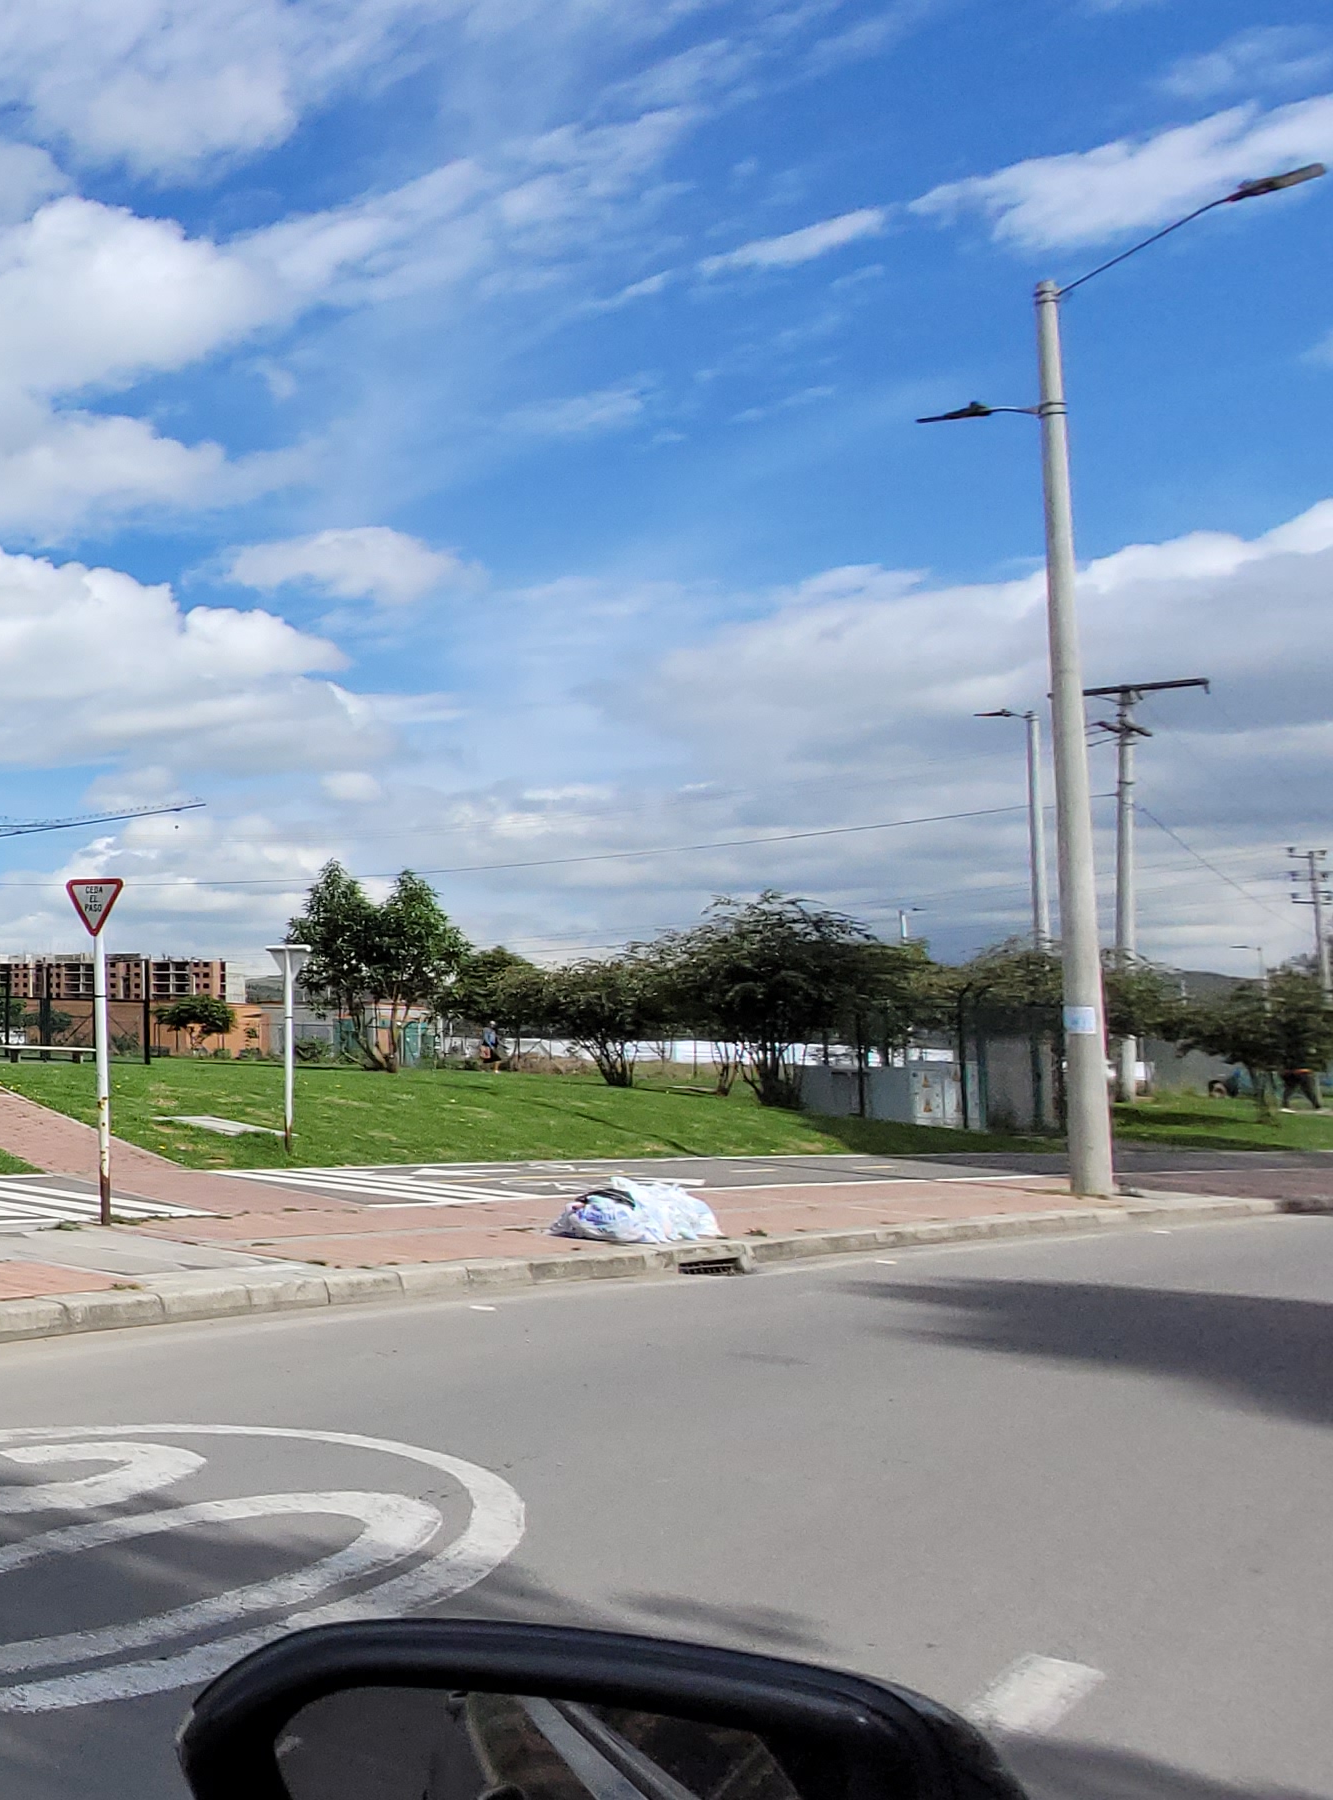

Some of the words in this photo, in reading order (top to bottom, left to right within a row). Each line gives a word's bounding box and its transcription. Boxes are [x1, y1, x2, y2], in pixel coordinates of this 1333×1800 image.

[85, 886, 103, 894] CEDA
[90, 895, 98, 903] EL
[84, 904, 102, 912] PASO
